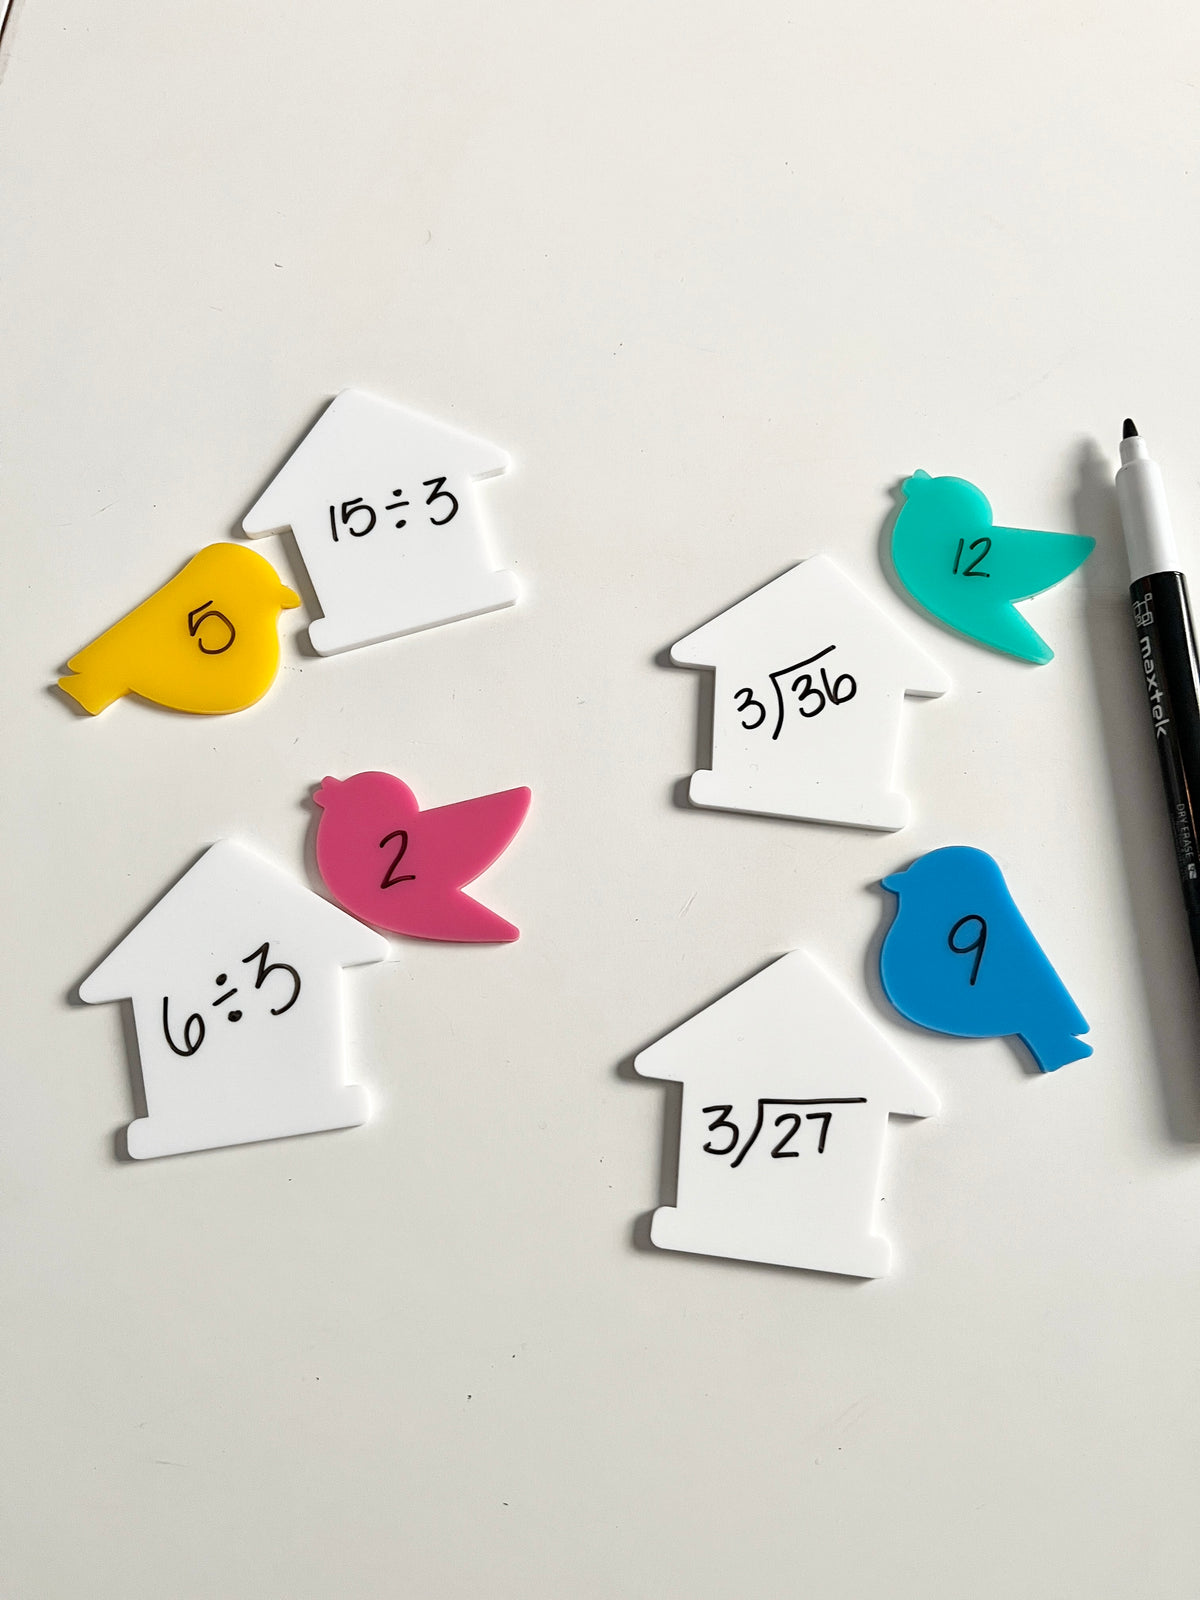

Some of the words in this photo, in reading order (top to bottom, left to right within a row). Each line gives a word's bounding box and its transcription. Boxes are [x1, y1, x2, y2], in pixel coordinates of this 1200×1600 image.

[952, 537, 992, 579] 12
[187, 600, 236, 655] 5
[1140, 635, 1170, 739] maxtek
[1175, 803, 1189, 823] DRY
[379, 829, 416, 890] 2
[947, 914, 988, 987] 9
